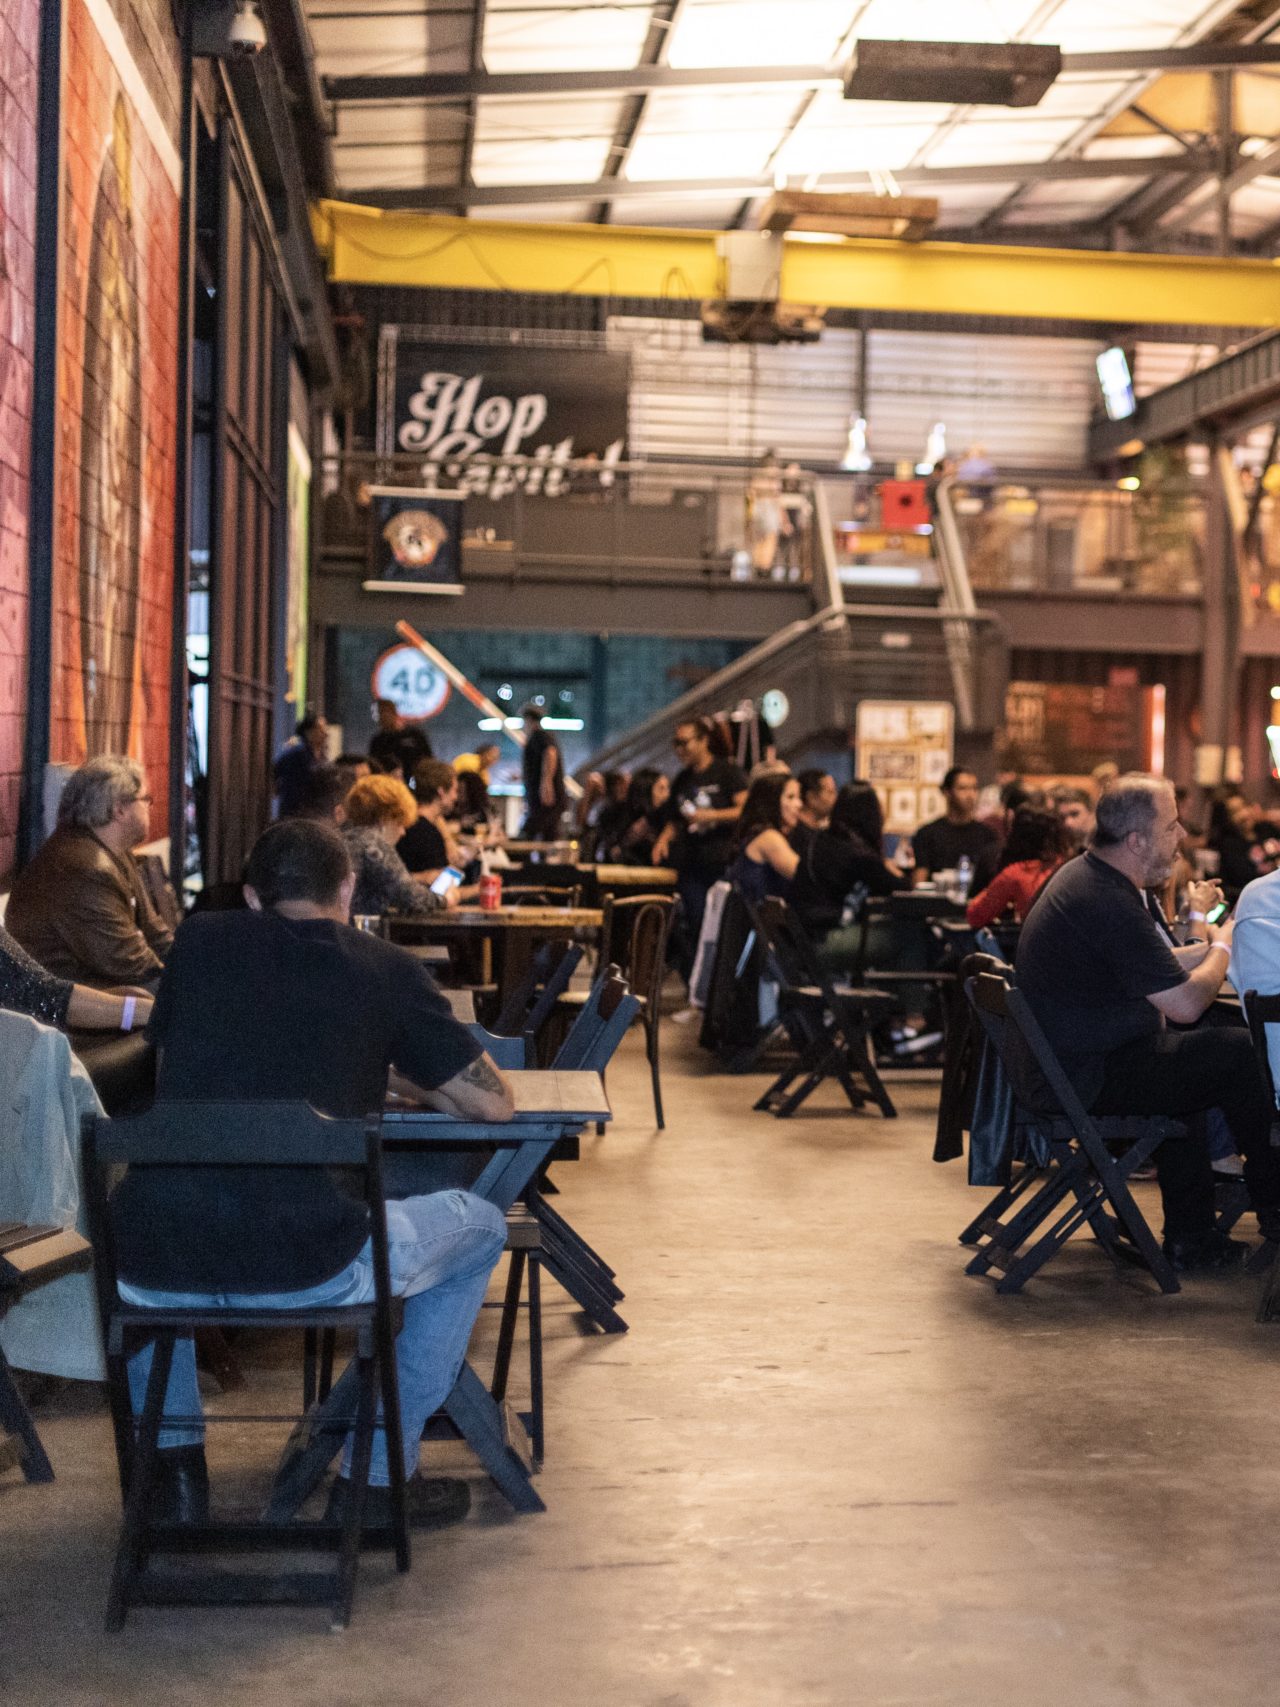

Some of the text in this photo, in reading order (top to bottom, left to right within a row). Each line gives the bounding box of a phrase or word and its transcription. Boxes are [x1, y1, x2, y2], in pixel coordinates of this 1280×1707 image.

[399, 371, 548, 456] Hop
[421, 431, 625, 500] Capitl
[390, 667, 436, 696] 40
